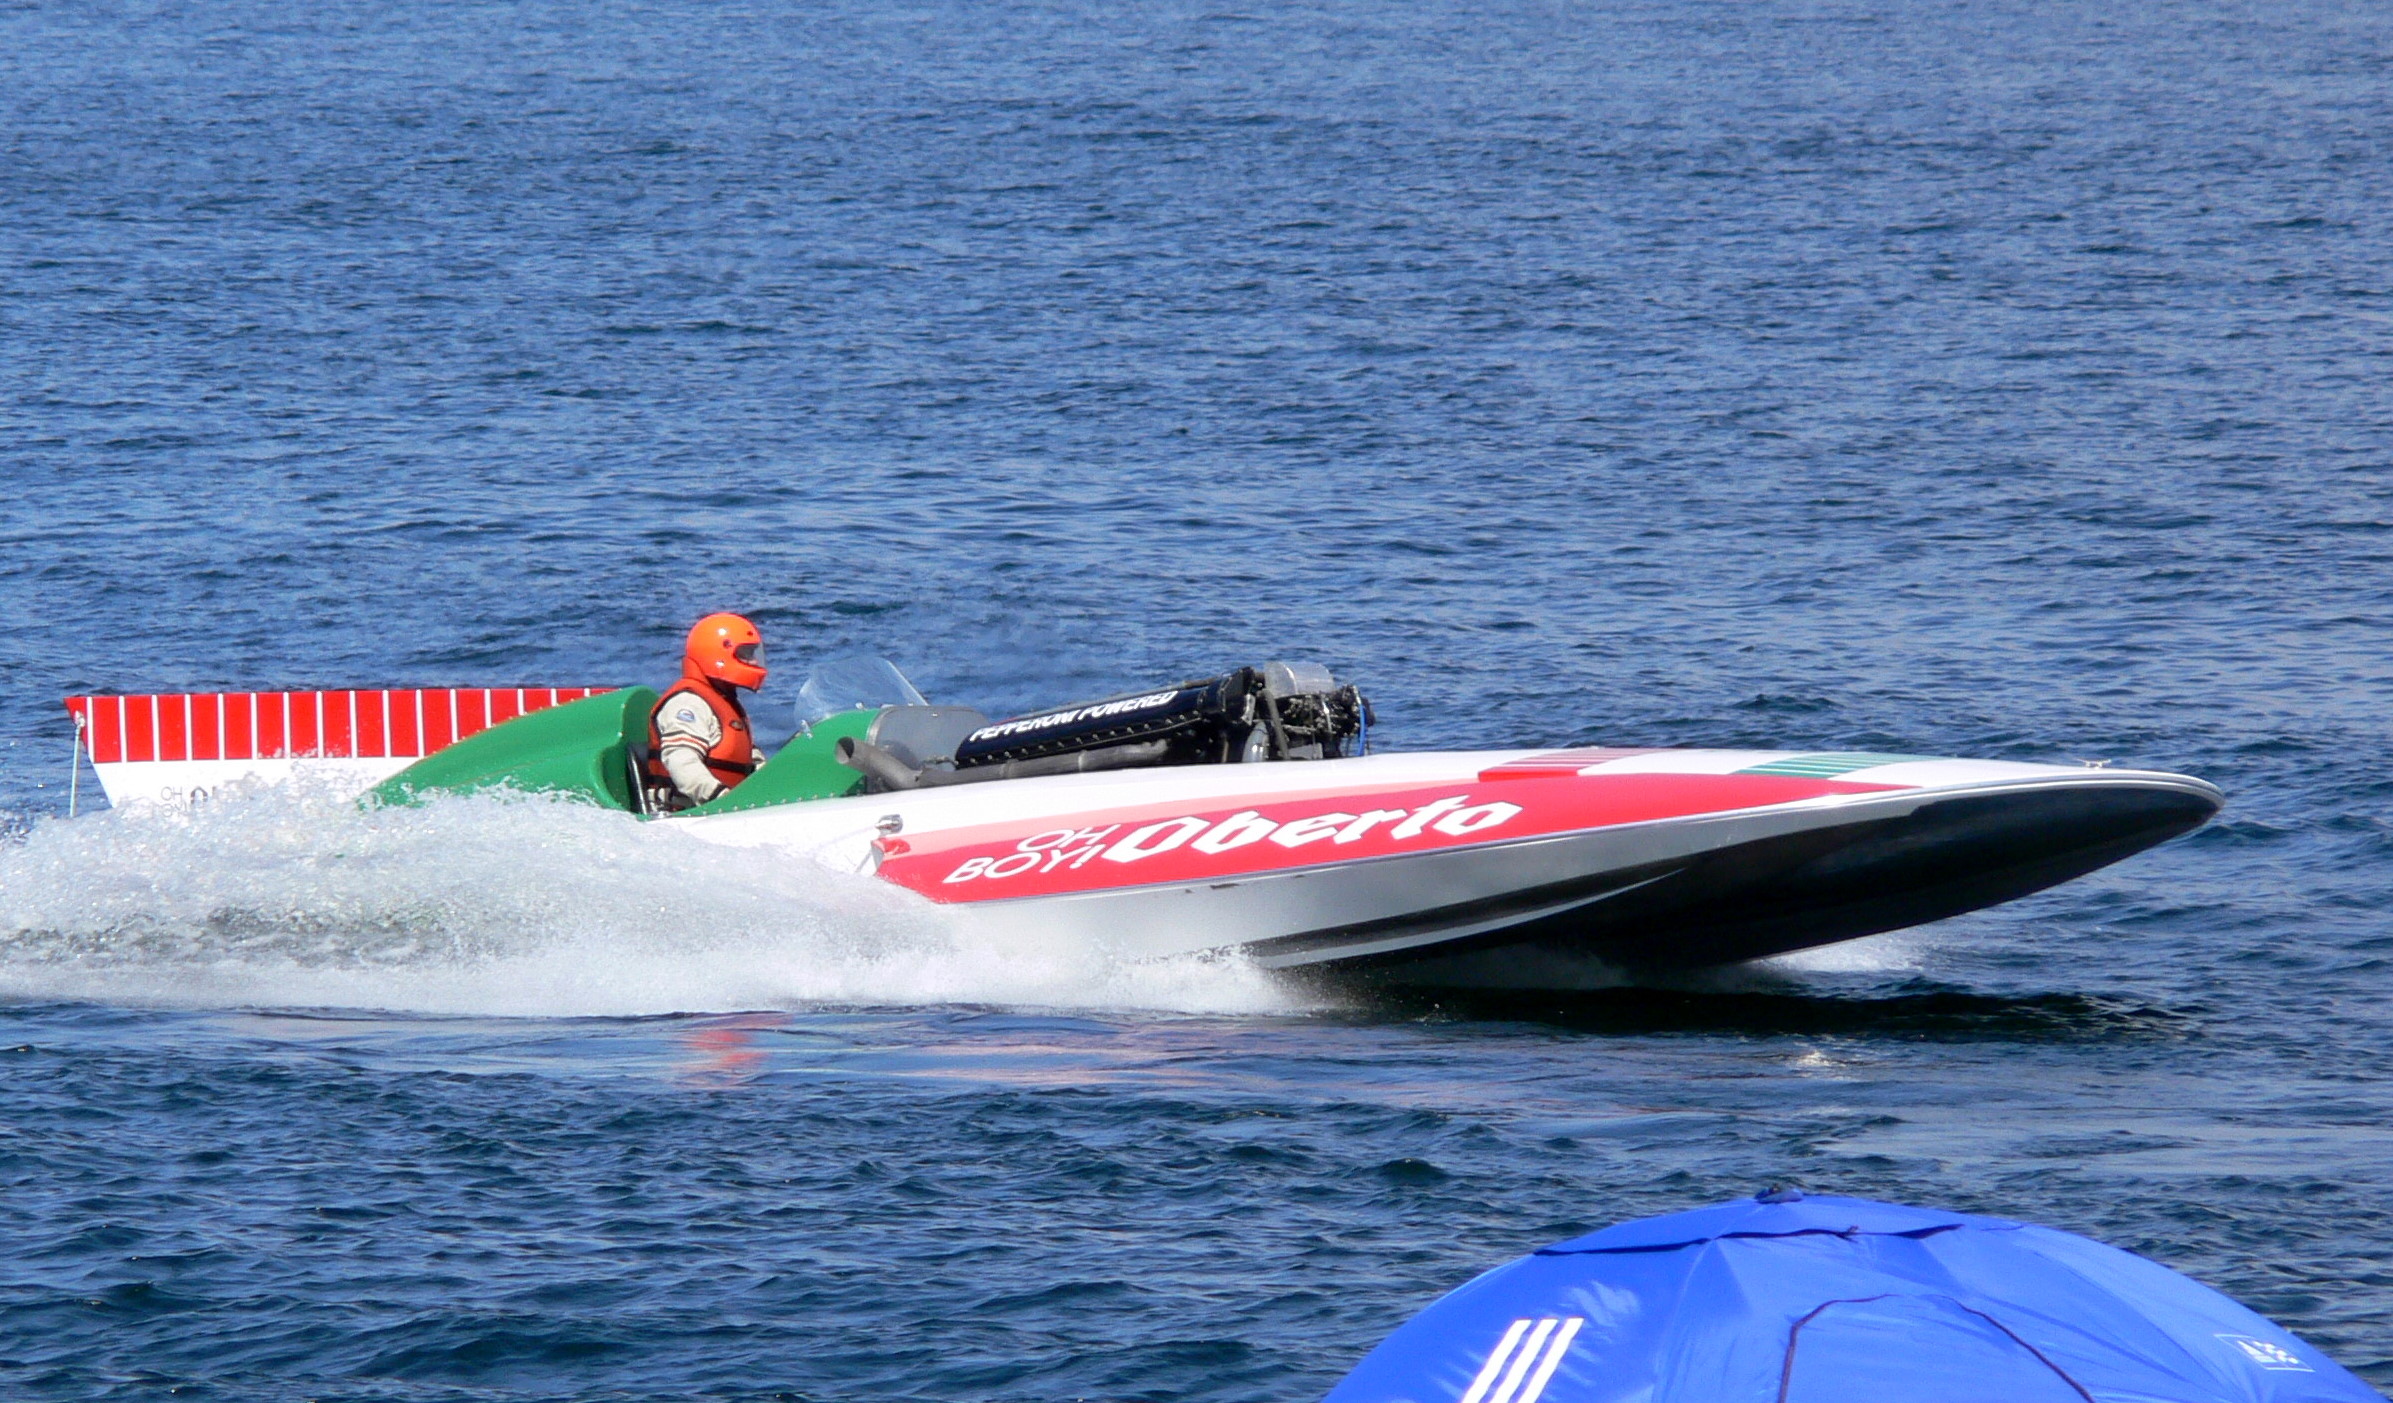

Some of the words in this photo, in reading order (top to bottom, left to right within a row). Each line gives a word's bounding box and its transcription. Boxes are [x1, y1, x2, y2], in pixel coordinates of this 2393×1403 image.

[969, 709, 1080, 742] PEPPERONI
[1078, 690, 1179, 720] POWERED
[1017, 823, 1121, 852] OH
[1101, 795, 1523, 863] Oberto
[942, 844, 1106, 884] BOY!
